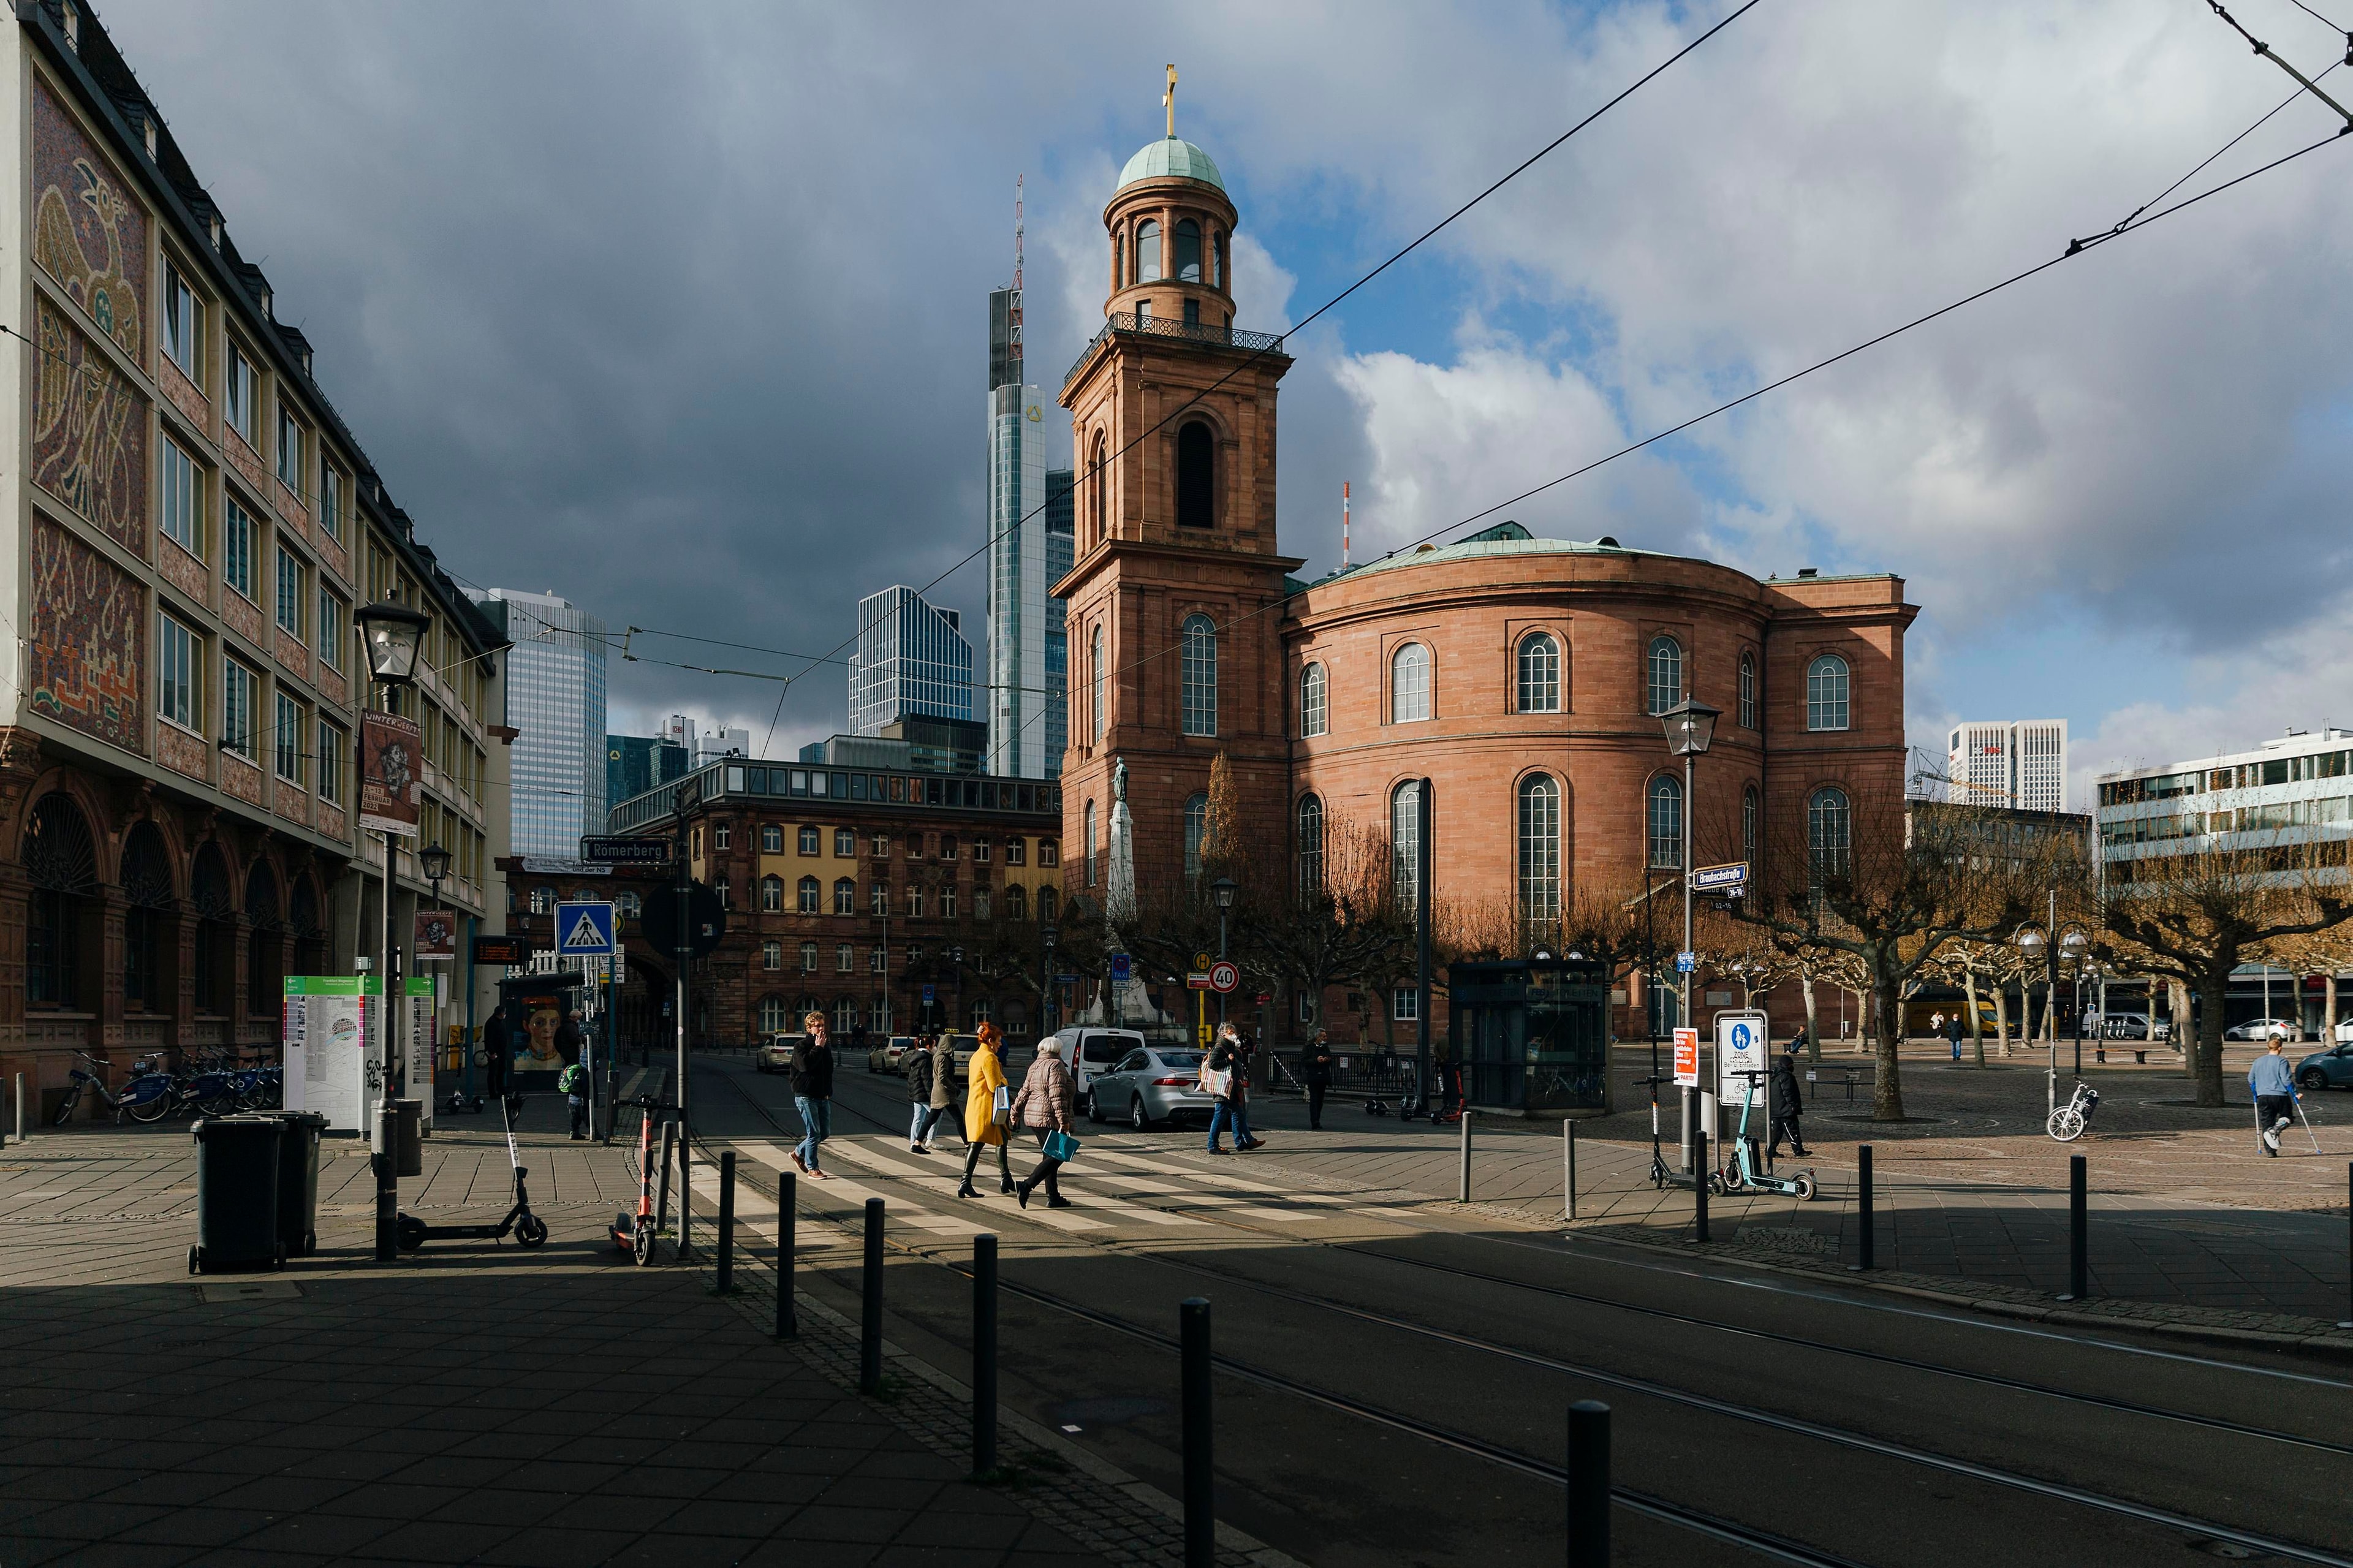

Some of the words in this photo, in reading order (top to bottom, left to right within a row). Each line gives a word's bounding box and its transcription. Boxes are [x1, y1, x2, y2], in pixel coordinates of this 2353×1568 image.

[365, 712, 417, 733] WINTERWERFT
[363, 793, 390, 804] FEBRUAR
[594, 843, 662, 859] Römerberg
[1699, 868, 1740, 884] Braubachstraße
[1215, 971, 1233, 984] 40
